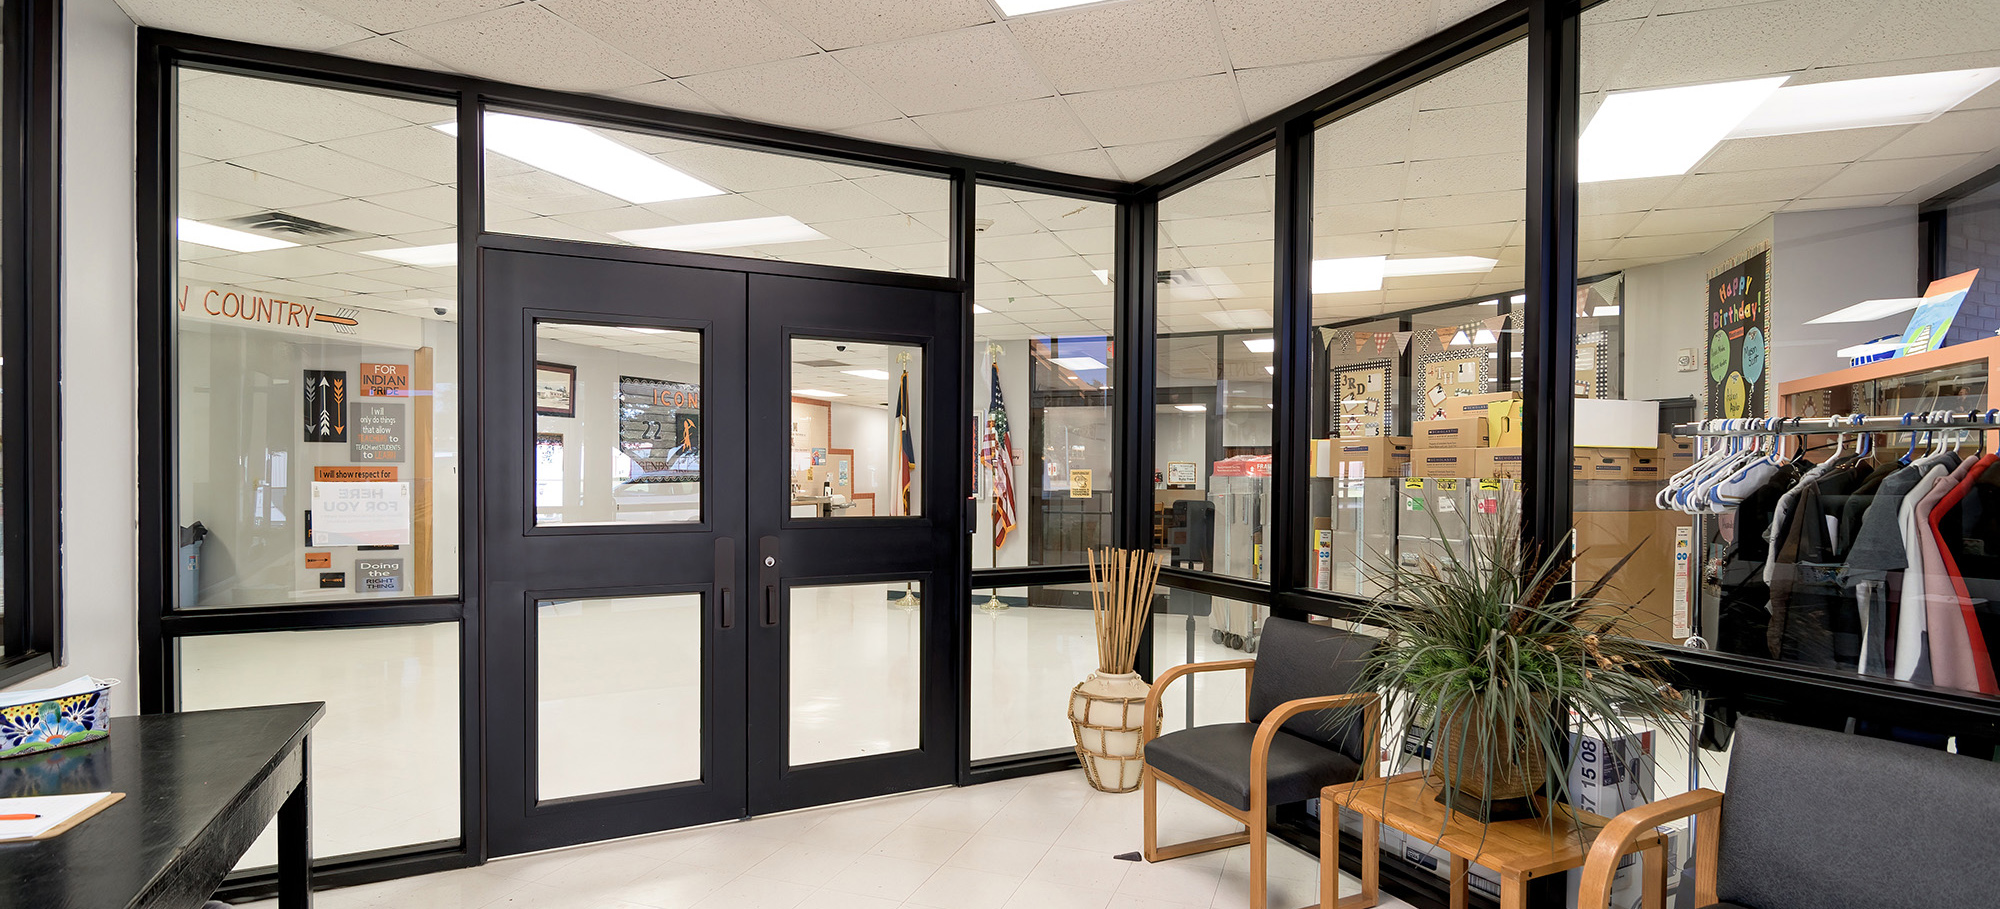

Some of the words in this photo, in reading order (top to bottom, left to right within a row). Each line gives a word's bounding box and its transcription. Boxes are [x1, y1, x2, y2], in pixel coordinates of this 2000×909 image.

[1720, 276, 1752, 303] Happy
[203, 289, 315, 328] COUNTRY
[1713, 291, 1761, 330] Birthday!
[374, 365, 397, 375] FOR
[363, 375, 406, 386] INDIAN
[1367, 374, 1372, 384] 1
[1341, 374, 1366, 395] 3RD
[371, 386, 400, 396] PRIDE
[653, 388, 698, 409] ICON
[371, 407, 374, 415] I
[374, 407, 384, 415] will
[360, 416, 371, 425] only
[372, 416, 380, 424] do
[380, 416, 396, 425] things
[362, 426, 374, 434] that
[376, 426, 391, 434] allow
[642, 420, 662, 440] 22
[1375, 427, 1380, 436] 5
[320, 470, 322, 478] I
[323, 470, 335, 478] will
[336, 470, 354, 478] show
[354, 470, 380, 479] respect
[381, 470, 391, 478] for
[360, 562, 399, 570] Doing
[1582, 740, 1596, 763] 08
[1582, 767, 1596, 788] 15
